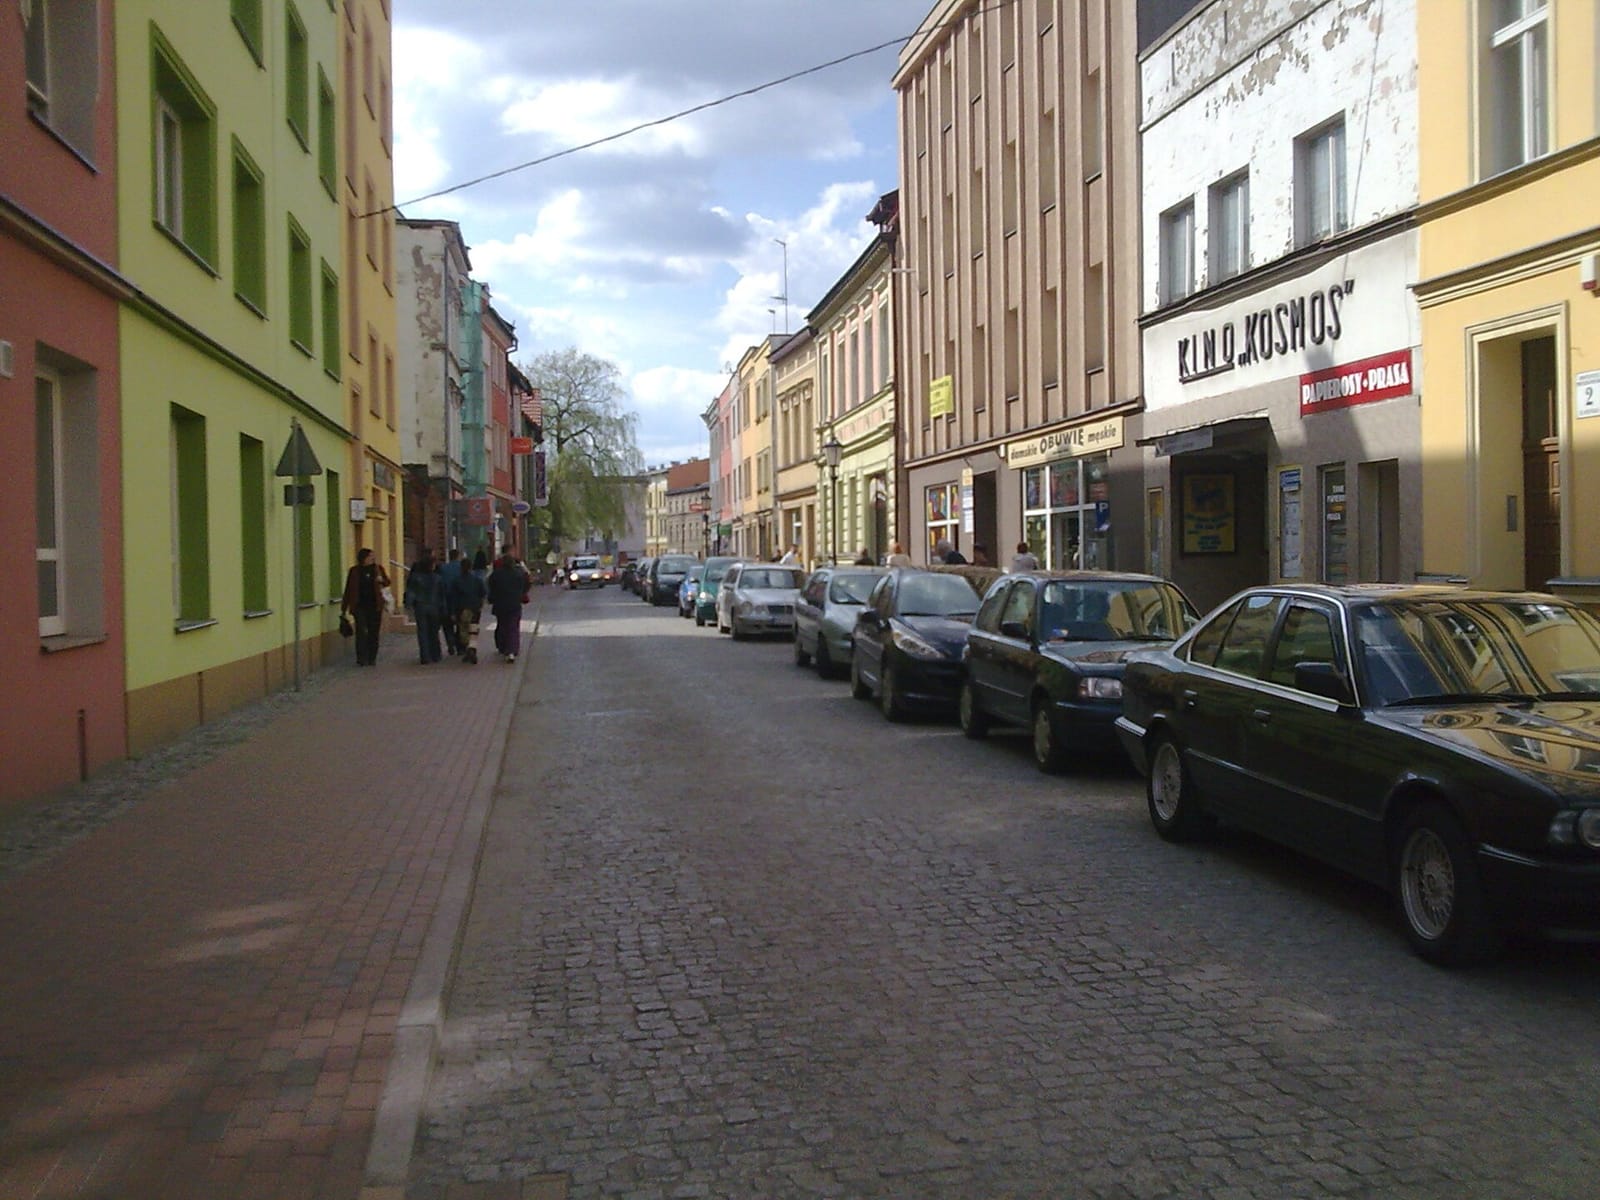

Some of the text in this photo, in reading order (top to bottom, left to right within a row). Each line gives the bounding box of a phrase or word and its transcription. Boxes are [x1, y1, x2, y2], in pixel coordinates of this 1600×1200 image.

[1178, 322, 1235, 382] KINO
[1302, 362, 1410, 404] PAPIEROSY PRASA
[1585, 387, 1593, 406] 2
[1010, 424, 1117, 460] damskie OBUWIE męskie
